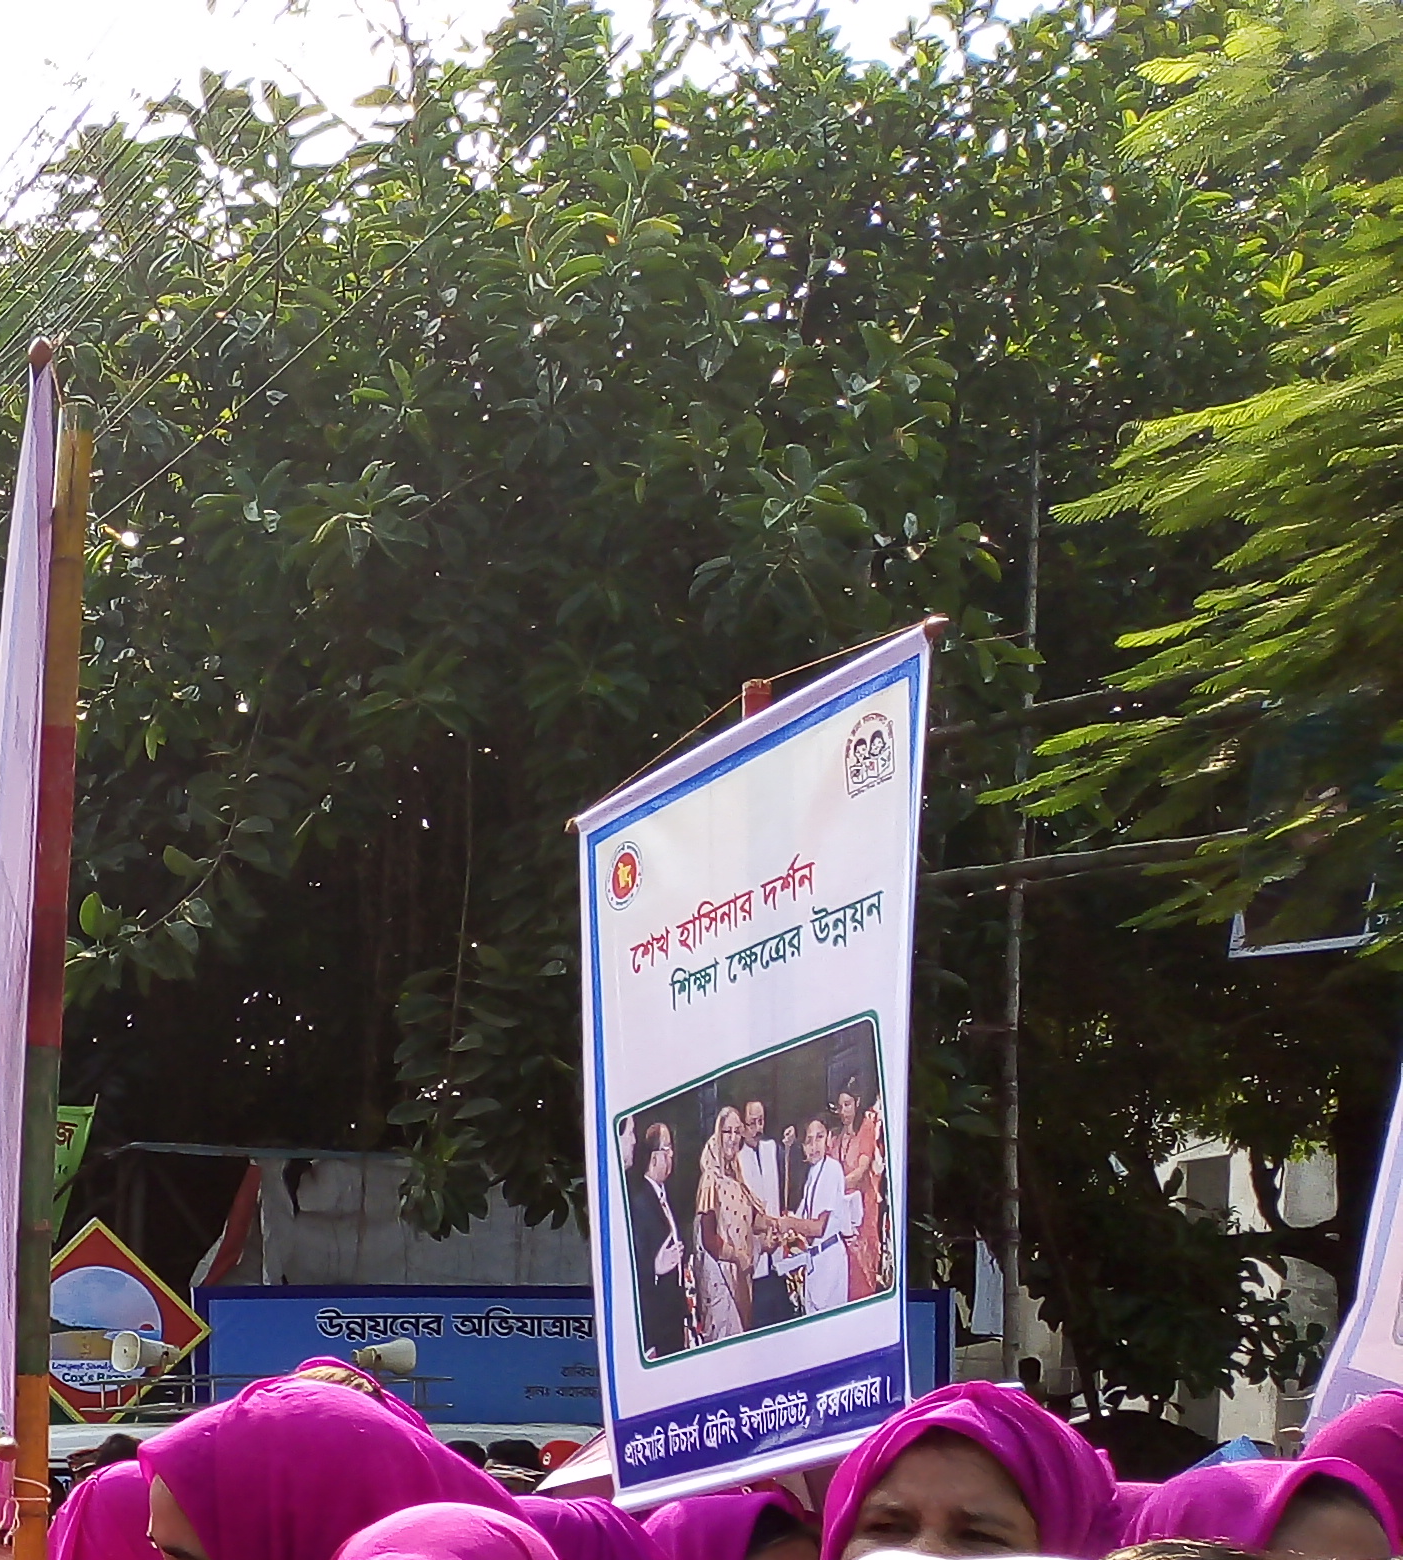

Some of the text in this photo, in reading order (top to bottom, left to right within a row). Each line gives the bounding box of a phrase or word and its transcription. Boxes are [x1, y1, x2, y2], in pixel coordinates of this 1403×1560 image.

[630, 853, 815, 974] শেখ হাসিনার দর্শন
[670, 891, 885, 1010] শিক্ষা ক্ষেত্রের উন্নয়ন
[315, 1307, 444, 1343] উন্নয়নের
